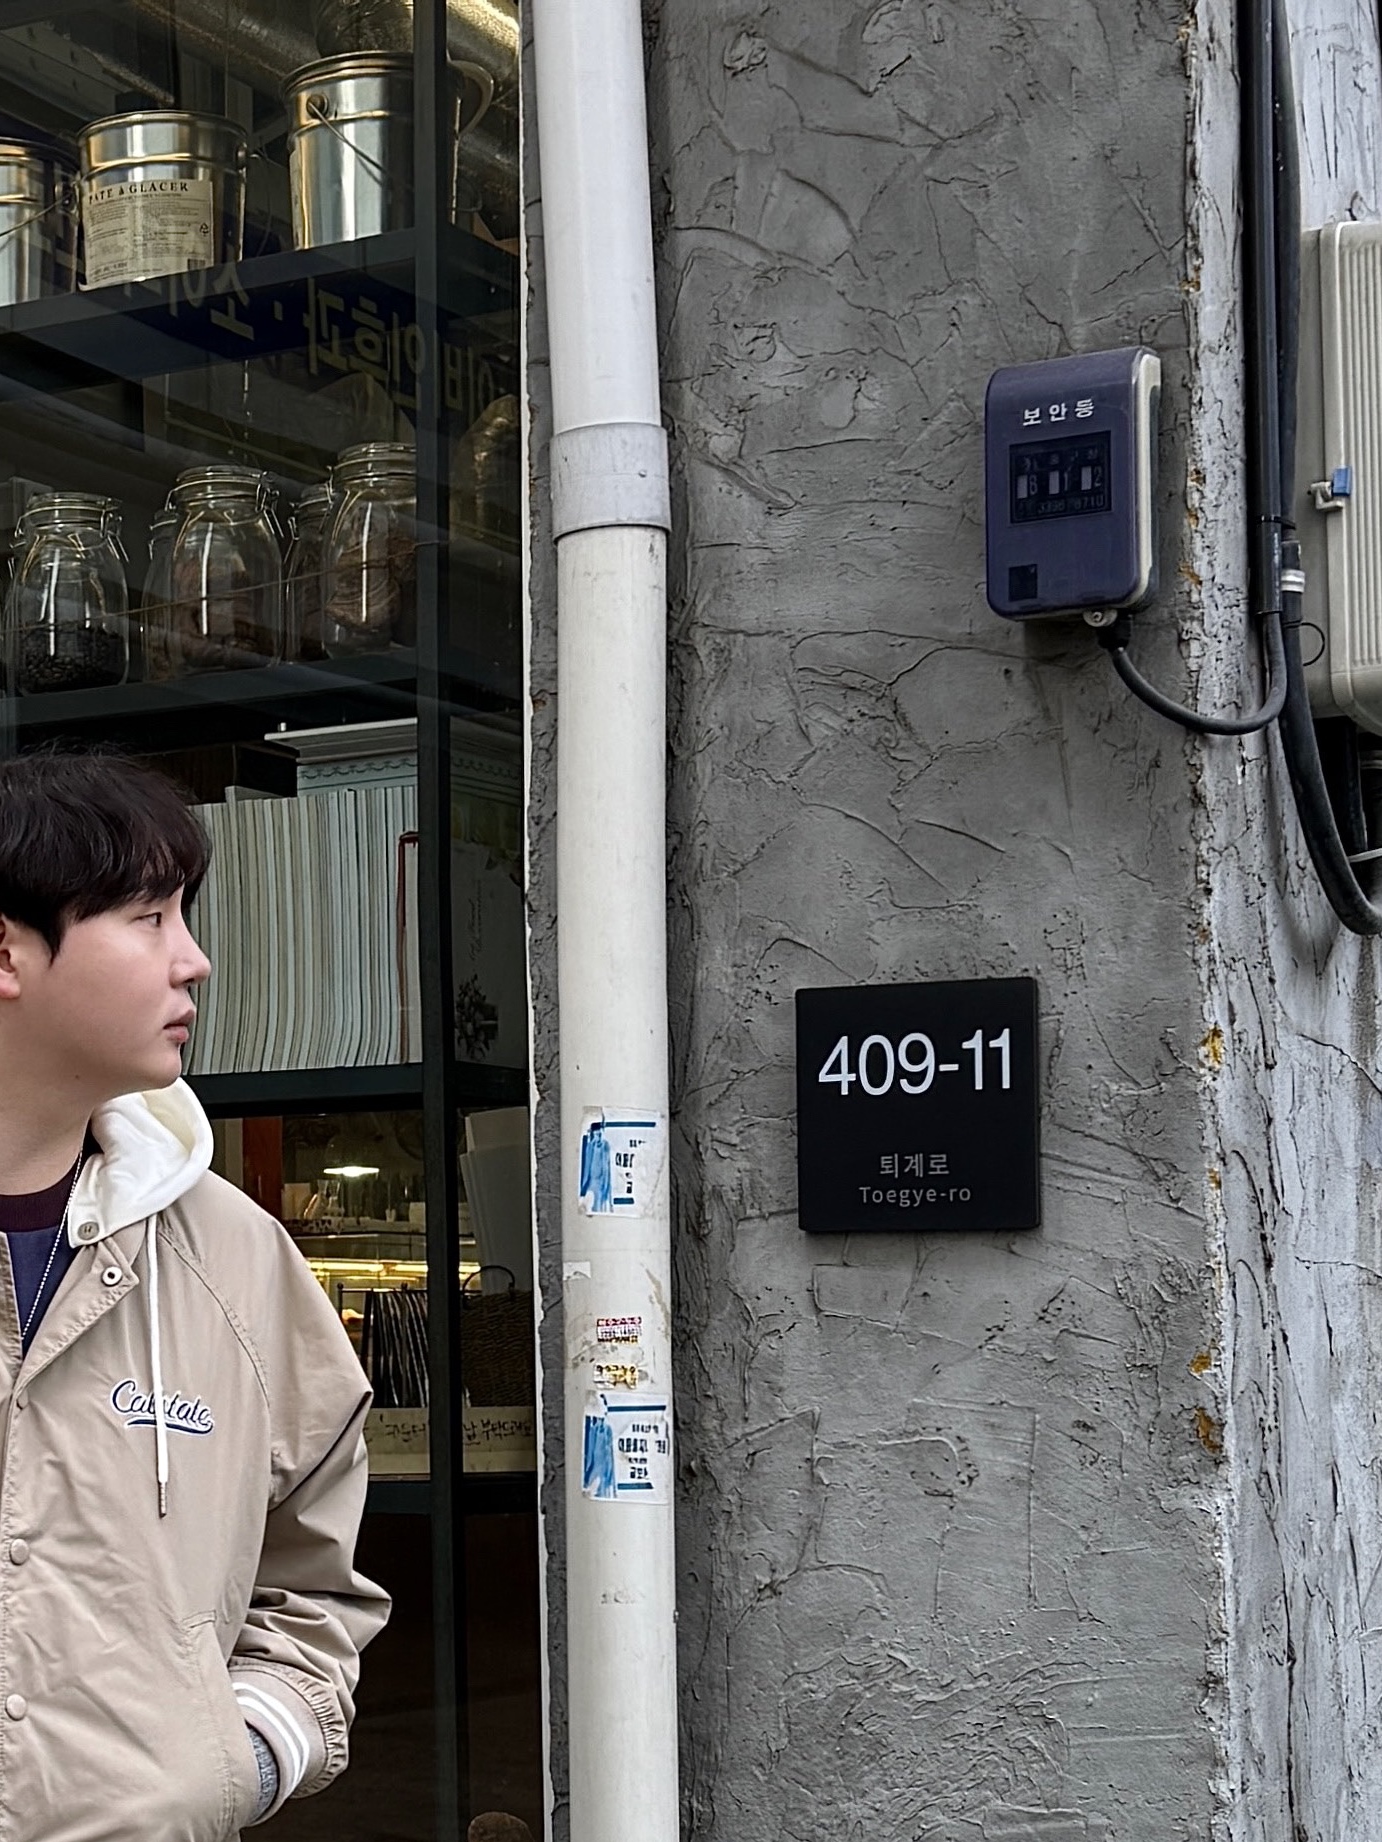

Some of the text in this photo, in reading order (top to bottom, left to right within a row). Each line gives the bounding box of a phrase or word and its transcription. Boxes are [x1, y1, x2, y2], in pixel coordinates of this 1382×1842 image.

[129, 181, 189, 195] GLACER
[1022, 397, 1095, 427] 보안등
[818, 1028, 1010, 1095] 409-11
[879, 1153, 950, 1179] 퇴계로
[858, 1186, 972, 1207] Toegye-ro
